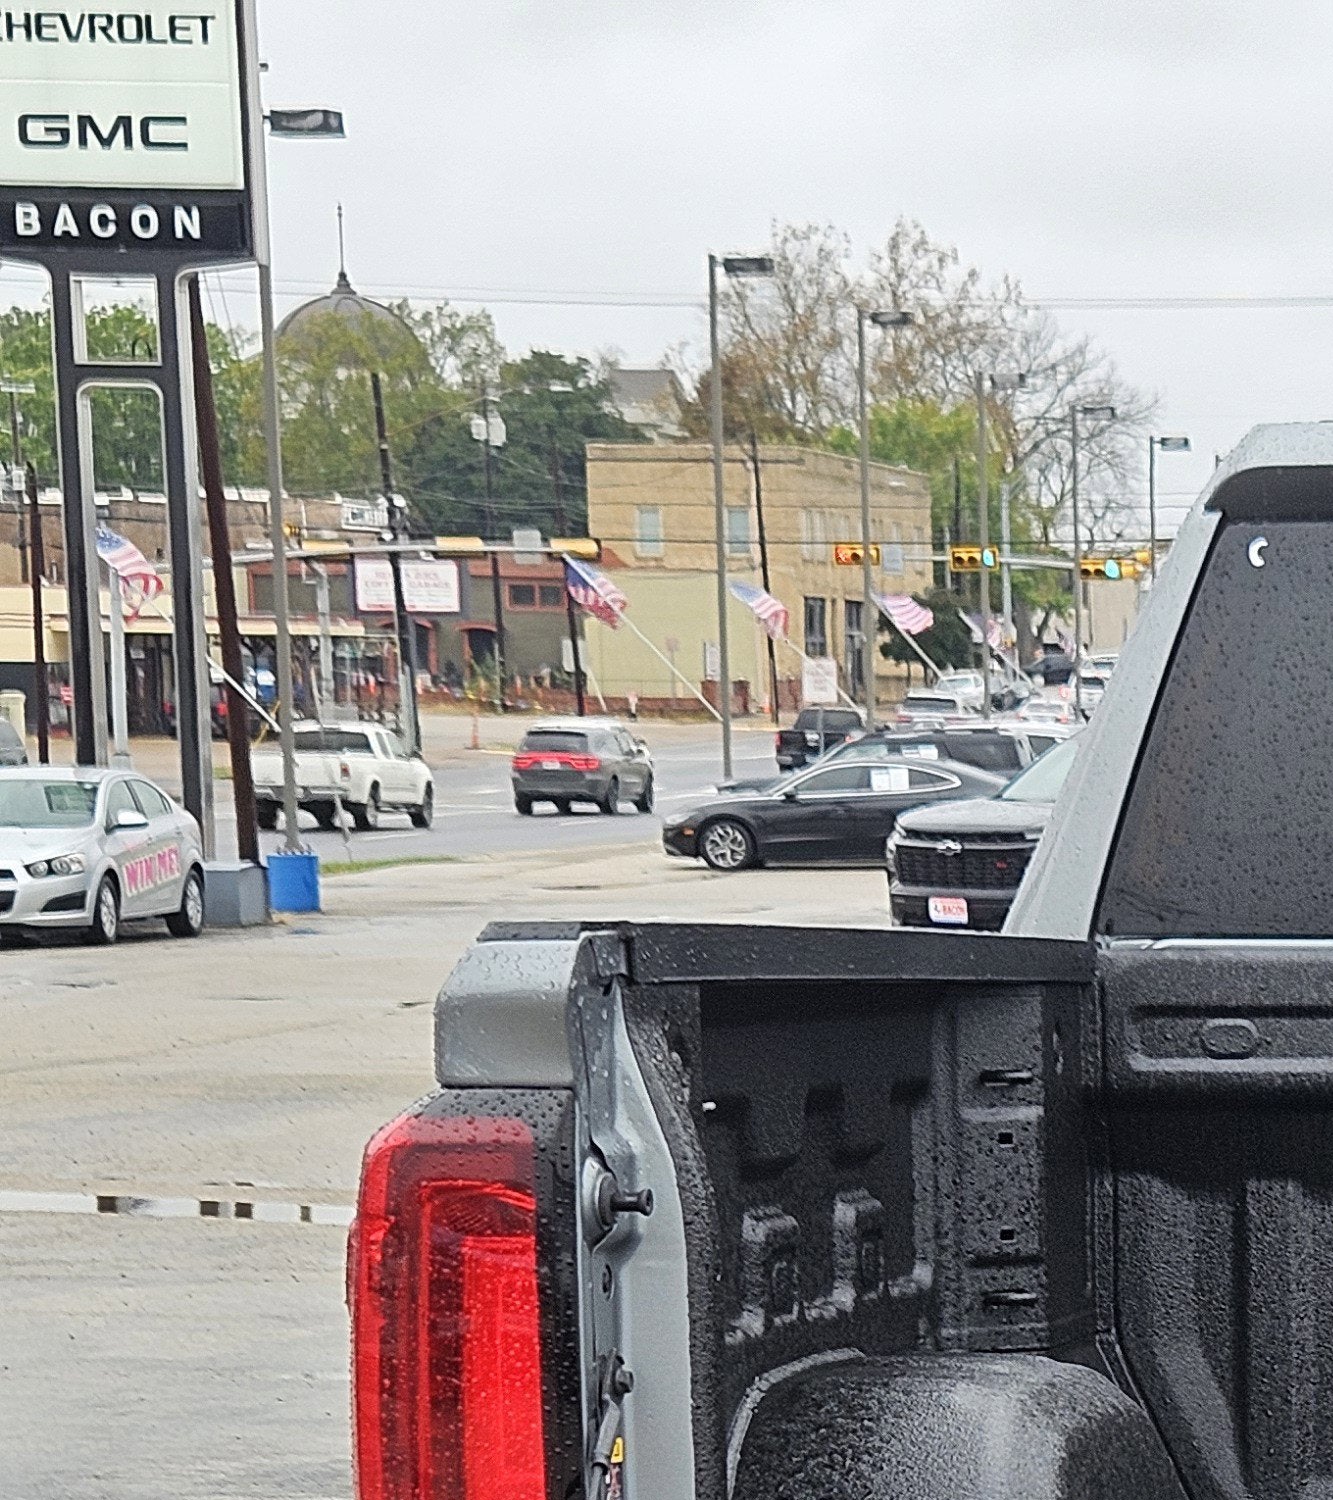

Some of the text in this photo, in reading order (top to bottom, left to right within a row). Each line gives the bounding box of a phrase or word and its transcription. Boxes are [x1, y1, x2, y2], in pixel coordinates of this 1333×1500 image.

[0, 12, 216, 45] HEVROLET
[18, 113, 188, 151] GMC
[15, 202, 201, 240] BACON
